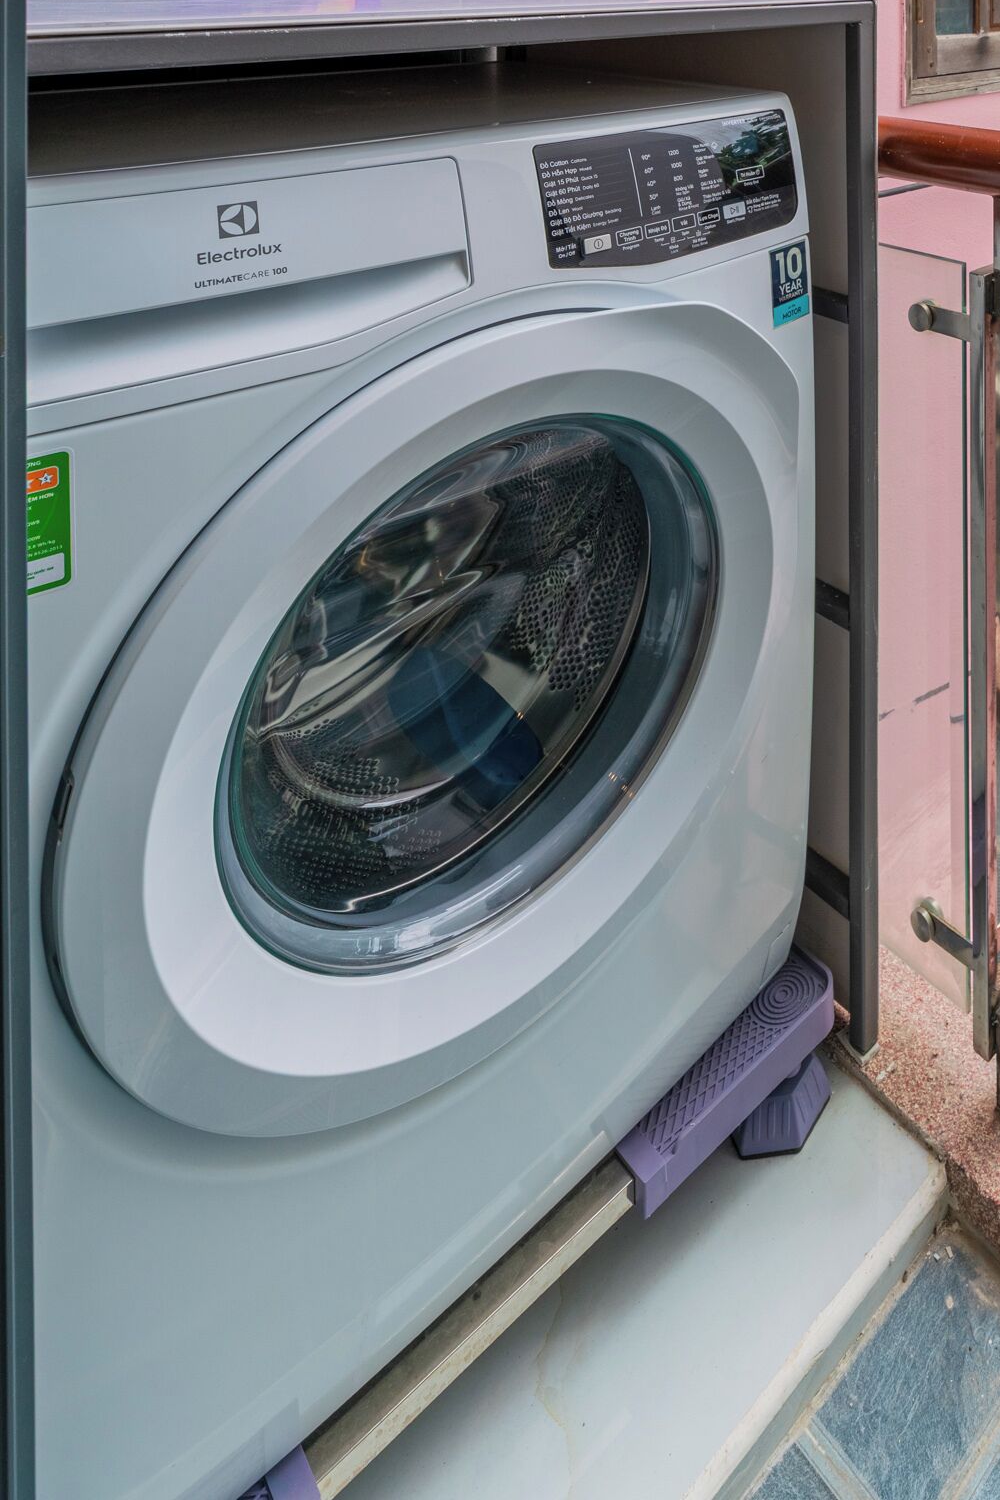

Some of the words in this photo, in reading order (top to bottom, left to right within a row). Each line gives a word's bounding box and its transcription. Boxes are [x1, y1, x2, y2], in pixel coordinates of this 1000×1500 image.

[550, 159, 569, 167] Cotton
[545, 190, 558, 198] Giặt
[567, 186, 581, 194] Phút
[559, 208, 570, 216] Len
[550, 219, 563, 227] Giặt
[551, 229, 565, 237] Giặt
[622, 243, 640, 252] Program
[197, 243, 282, 266] Electrolux
[775, 247, 803, 284] 10
[194, 269, 270, 289] ULTIMATECARE
[272, 266, 288, 276] 100
[779, 278, 803, 295] YEAR
[778, 288, 804, 303] WARRANTY
[782, 306, 802, 320] MOTOR
